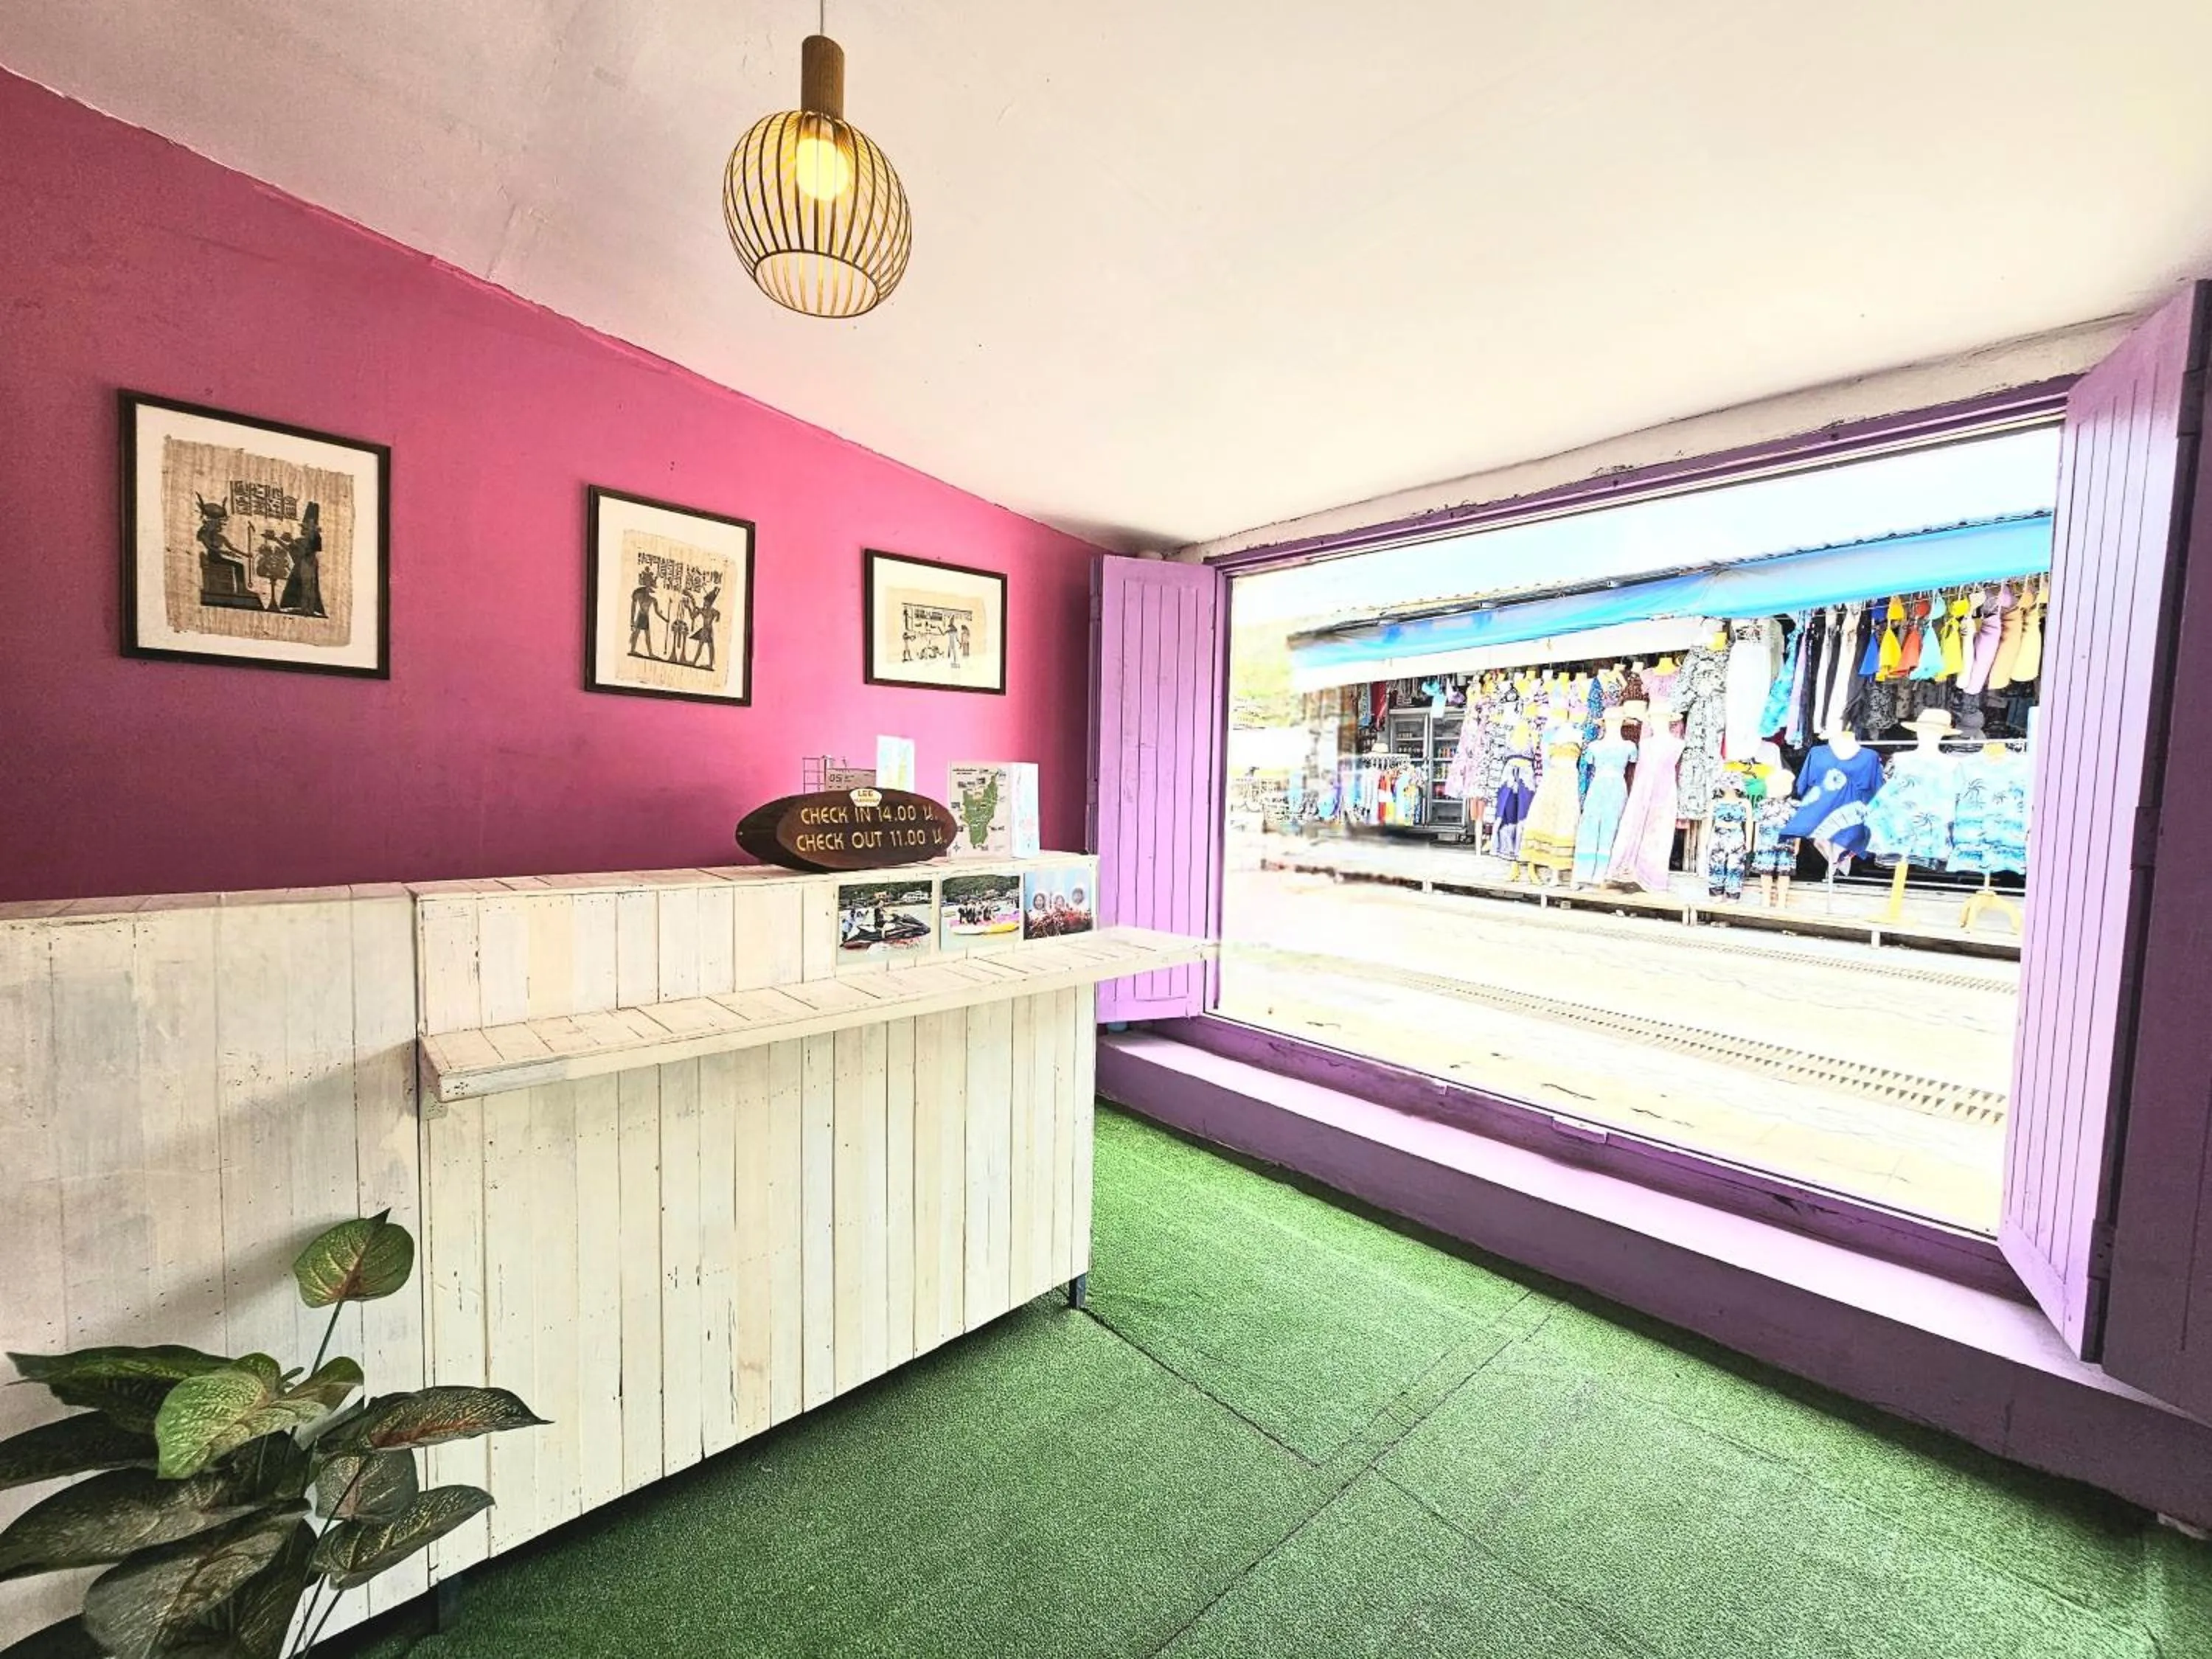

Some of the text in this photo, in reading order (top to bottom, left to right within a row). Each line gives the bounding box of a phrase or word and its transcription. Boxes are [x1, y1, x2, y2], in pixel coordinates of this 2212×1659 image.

[801, 806, 849, 824] CHECK
[855, 807, 871, 824] IN
[877, 805, 917, 822] 14.00
[796, 832, 844, 852] CHECK
[852, 831, 883, 849] OUT
[889, 829, 925, 847] 11.00
